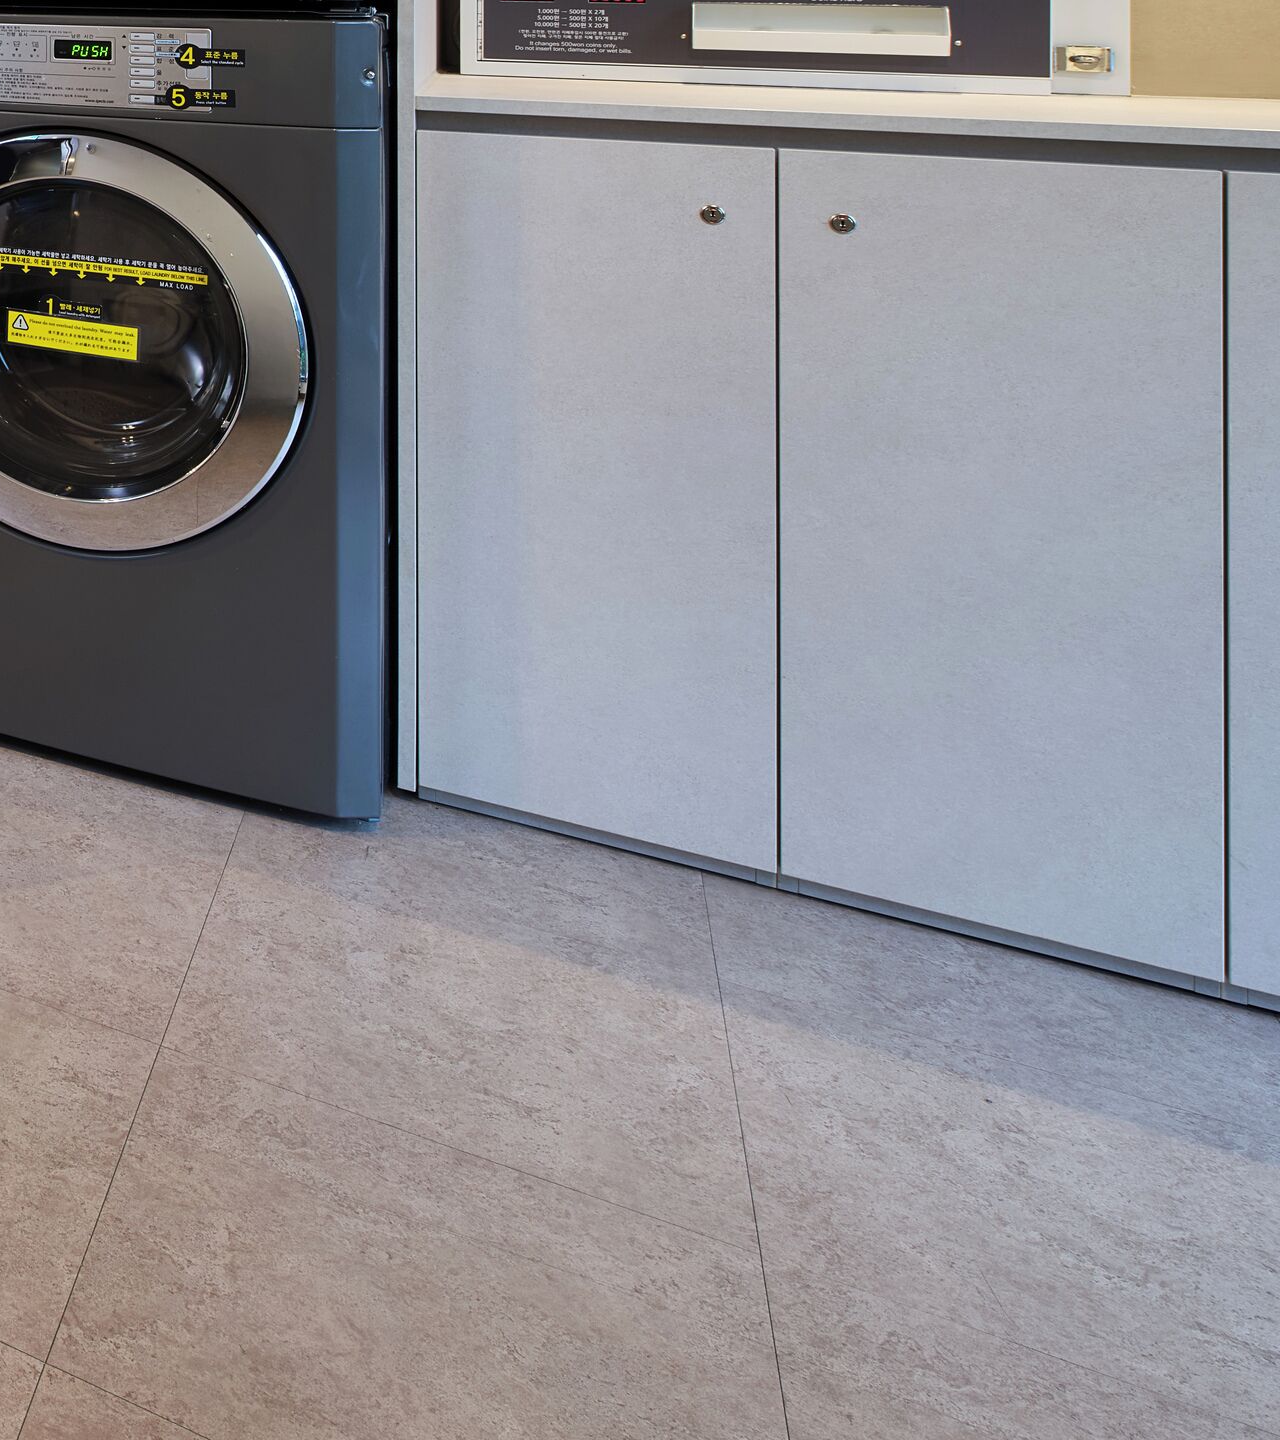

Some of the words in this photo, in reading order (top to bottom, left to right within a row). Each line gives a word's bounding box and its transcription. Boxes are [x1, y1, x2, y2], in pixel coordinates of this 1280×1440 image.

[71, 44, 109, 58] PUSH
[180, 46, 196, 65] 4
[204, 51, 221, 60] 표준
[222, 51, 239, 60] 누름
[171, 88, 186, 107] 5
[194, 91, 210, 100] 동작
[212, 91, 229, 100] 누름
[176, 282, 194, 291] LOAD
